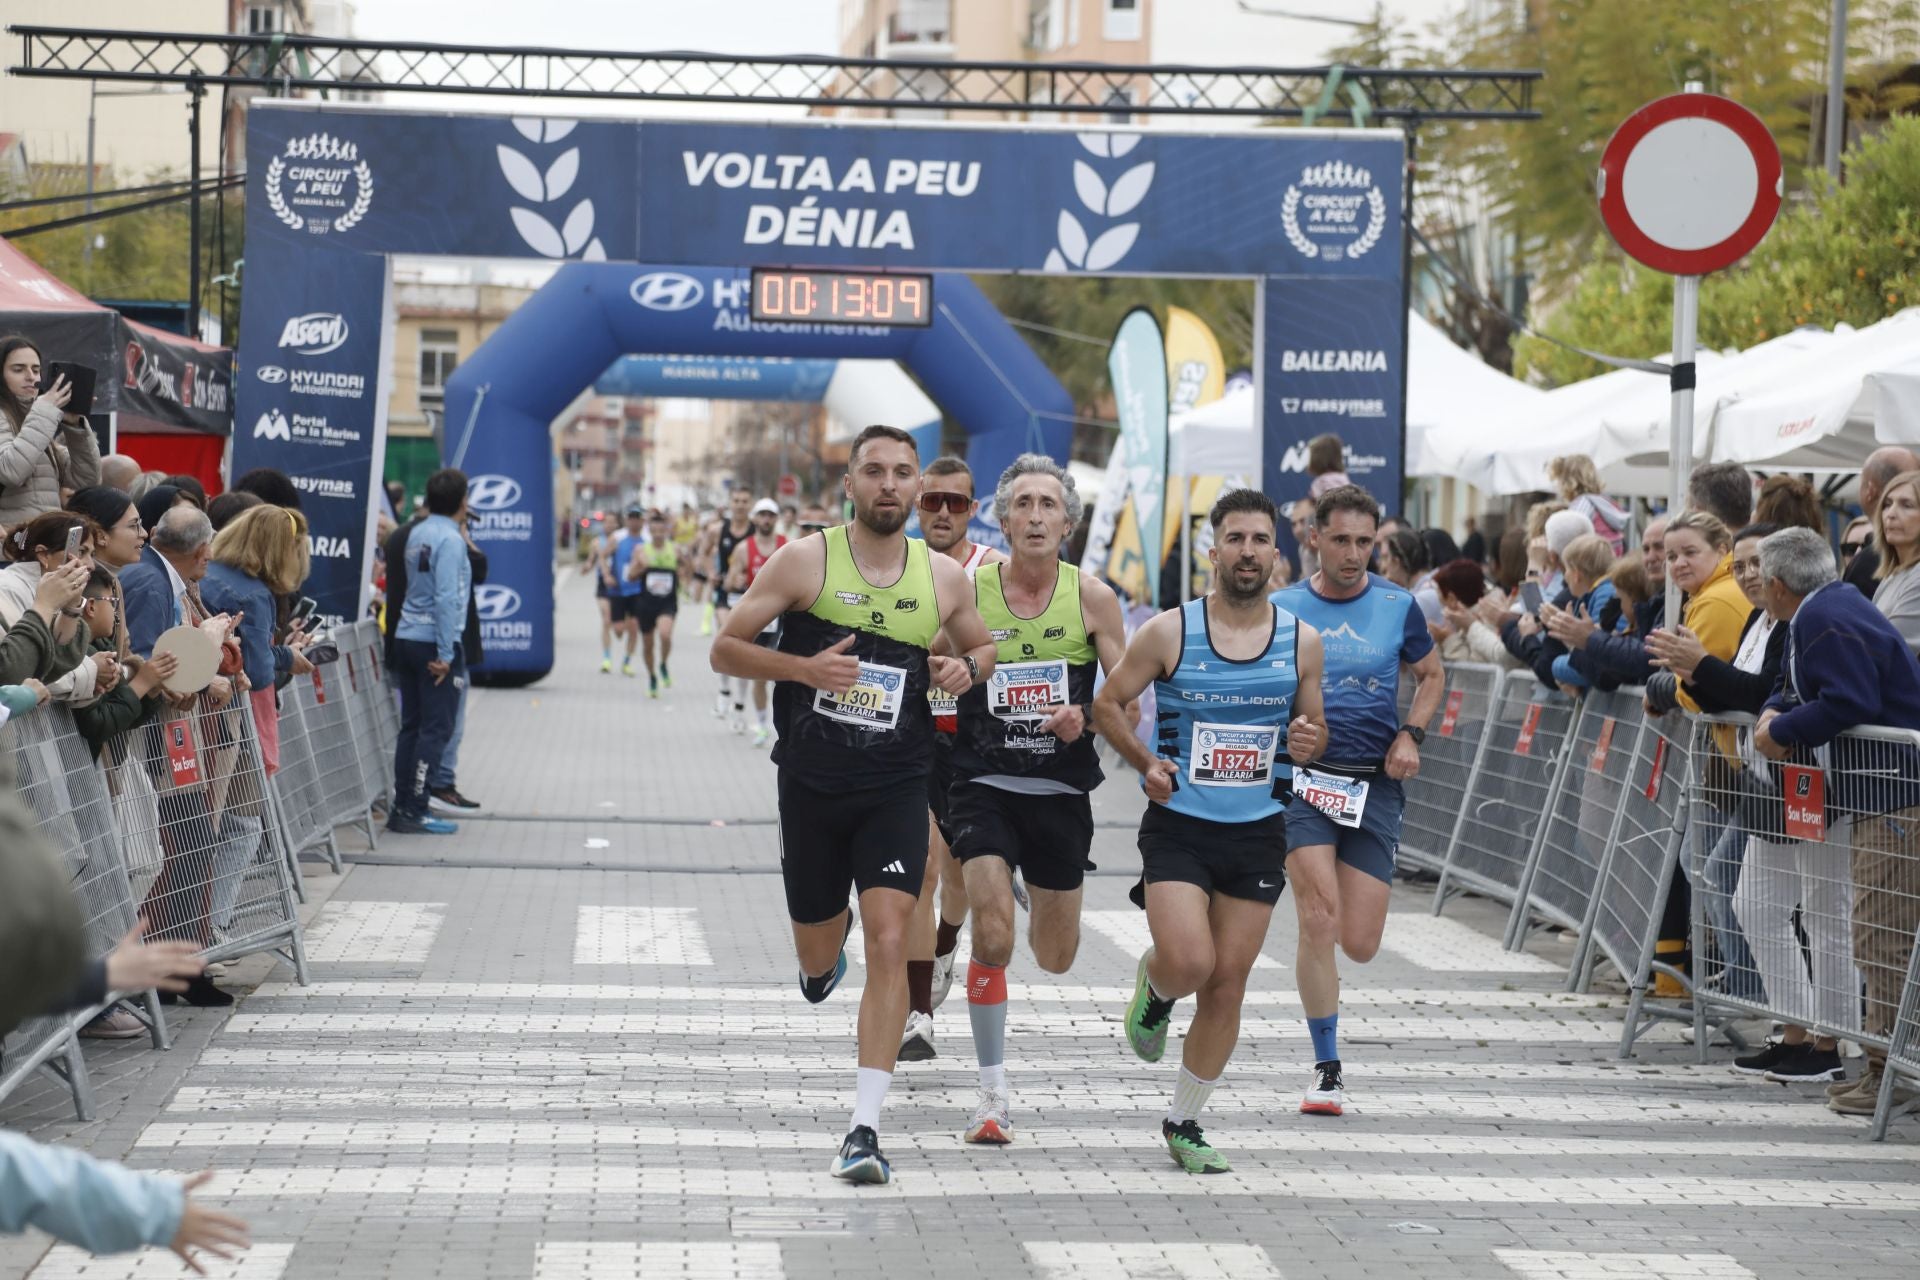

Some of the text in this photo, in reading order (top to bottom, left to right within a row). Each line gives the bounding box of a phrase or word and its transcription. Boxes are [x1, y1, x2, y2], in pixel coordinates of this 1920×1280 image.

[288, 166, 351, 182] CIRCUIT
[683, 151, 981, 197] VOLTA A PEU
[295, 181, 343, 196] A PEU
[293, 197, 346, 208] MARINA ALTA
[1303, 194, 1365, 209] CIRCUIT
[744, 196, 915, 250] DÉNIA
[1309, 209, 1357, 223] A PEU
[762, 275, 922, 318] 00:13:09
[278, 313, 343, 348] Asevi
[1281, 351, 1388, 372] BALEARIA
[290, 370, 365, 390] HYUNDAI
[1302, 399, 1385, 416] masymas
[292, 413, 328, 428] Portal
[292, 425, 360, 441] de la Marina
[291, 476, 354, 494] asymas
[895, 598, 917, 610] Asevi
[1043, 626, 1064, 639] Asevi
[1357, 645, 1385, 657] TRAIL
[841, 689, 878, 709] 1301
[998, 688, 1048, 705] E 1464
[836, 703, 877, 719] BALEARIA
[1202, 753, 1256, 770] S 1374
[1213, 770, 1255, 779] BALEARIA
[1309, 791, 1343, 810] 1395
